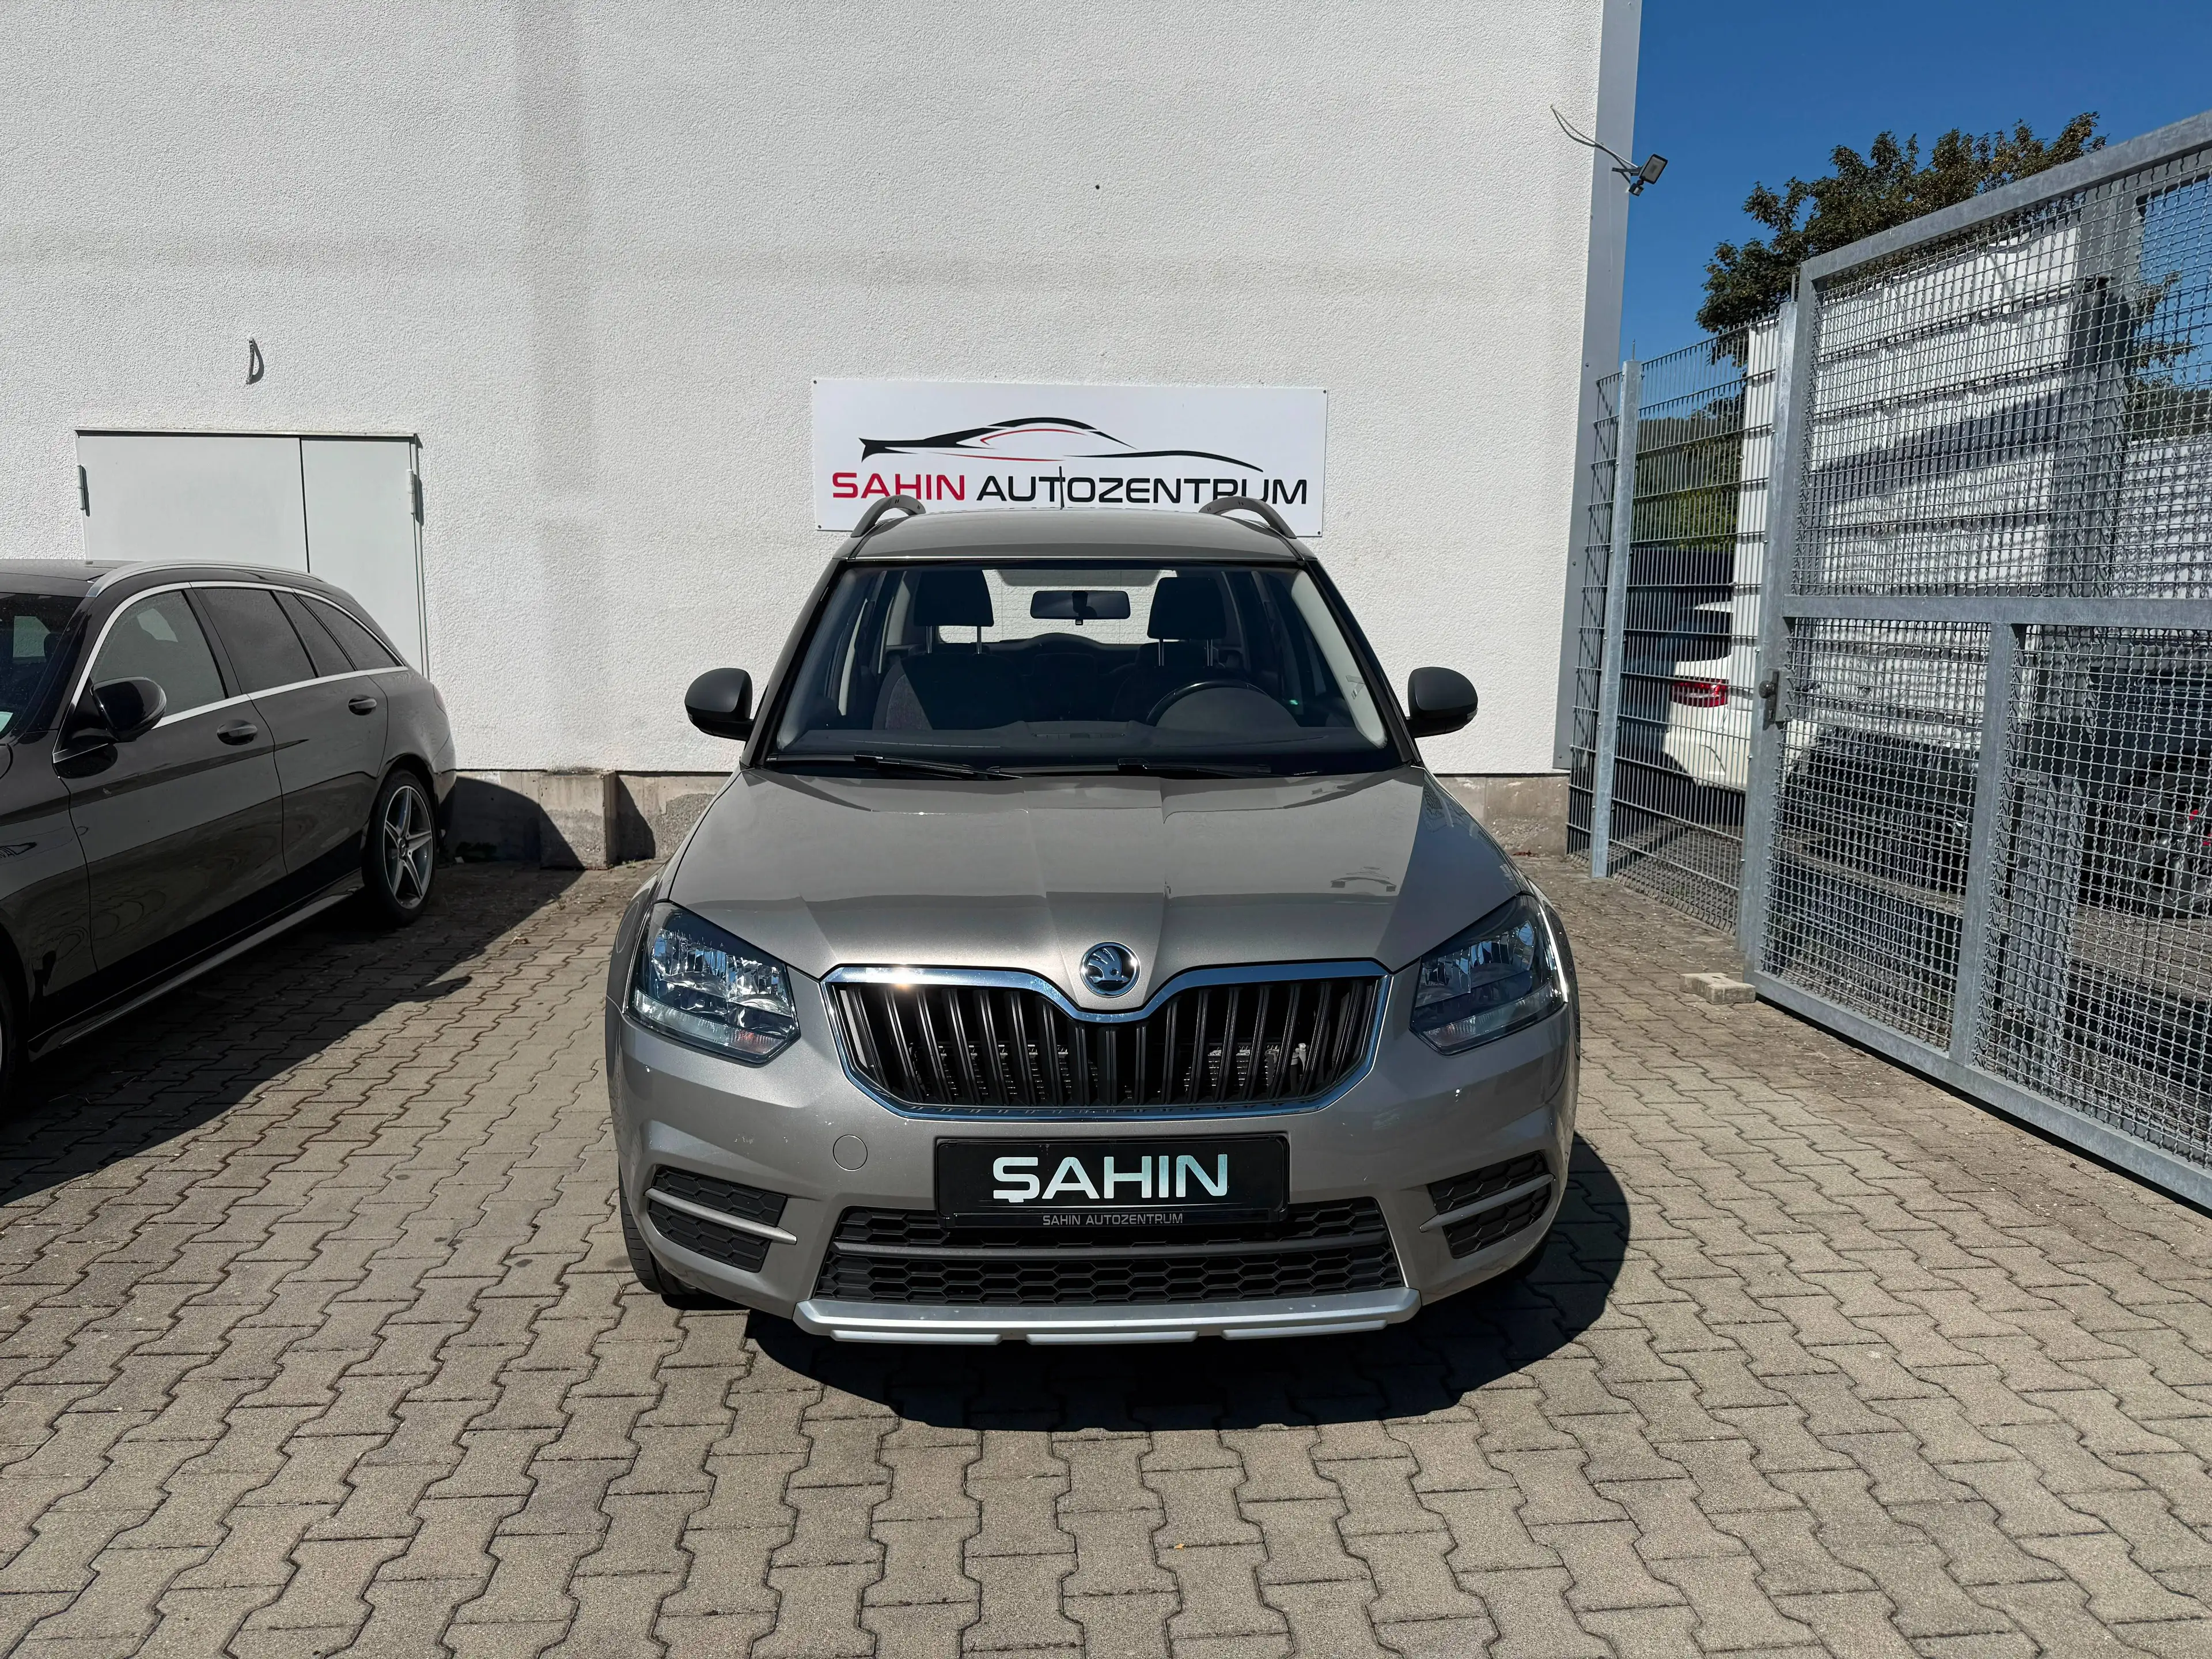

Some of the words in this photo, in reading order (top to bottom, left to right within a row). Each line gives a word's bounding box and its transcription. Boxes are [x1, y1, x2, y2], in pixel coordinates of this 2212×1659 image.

[832, 472, 965, 501] SAHIN
[976, 475, 1308, 505] AUTOZENTRUM
[1043, 1214, 1081, 1226] SAHIN
[1085, 1213, 1183, 1225] AUTOZENTRUM
